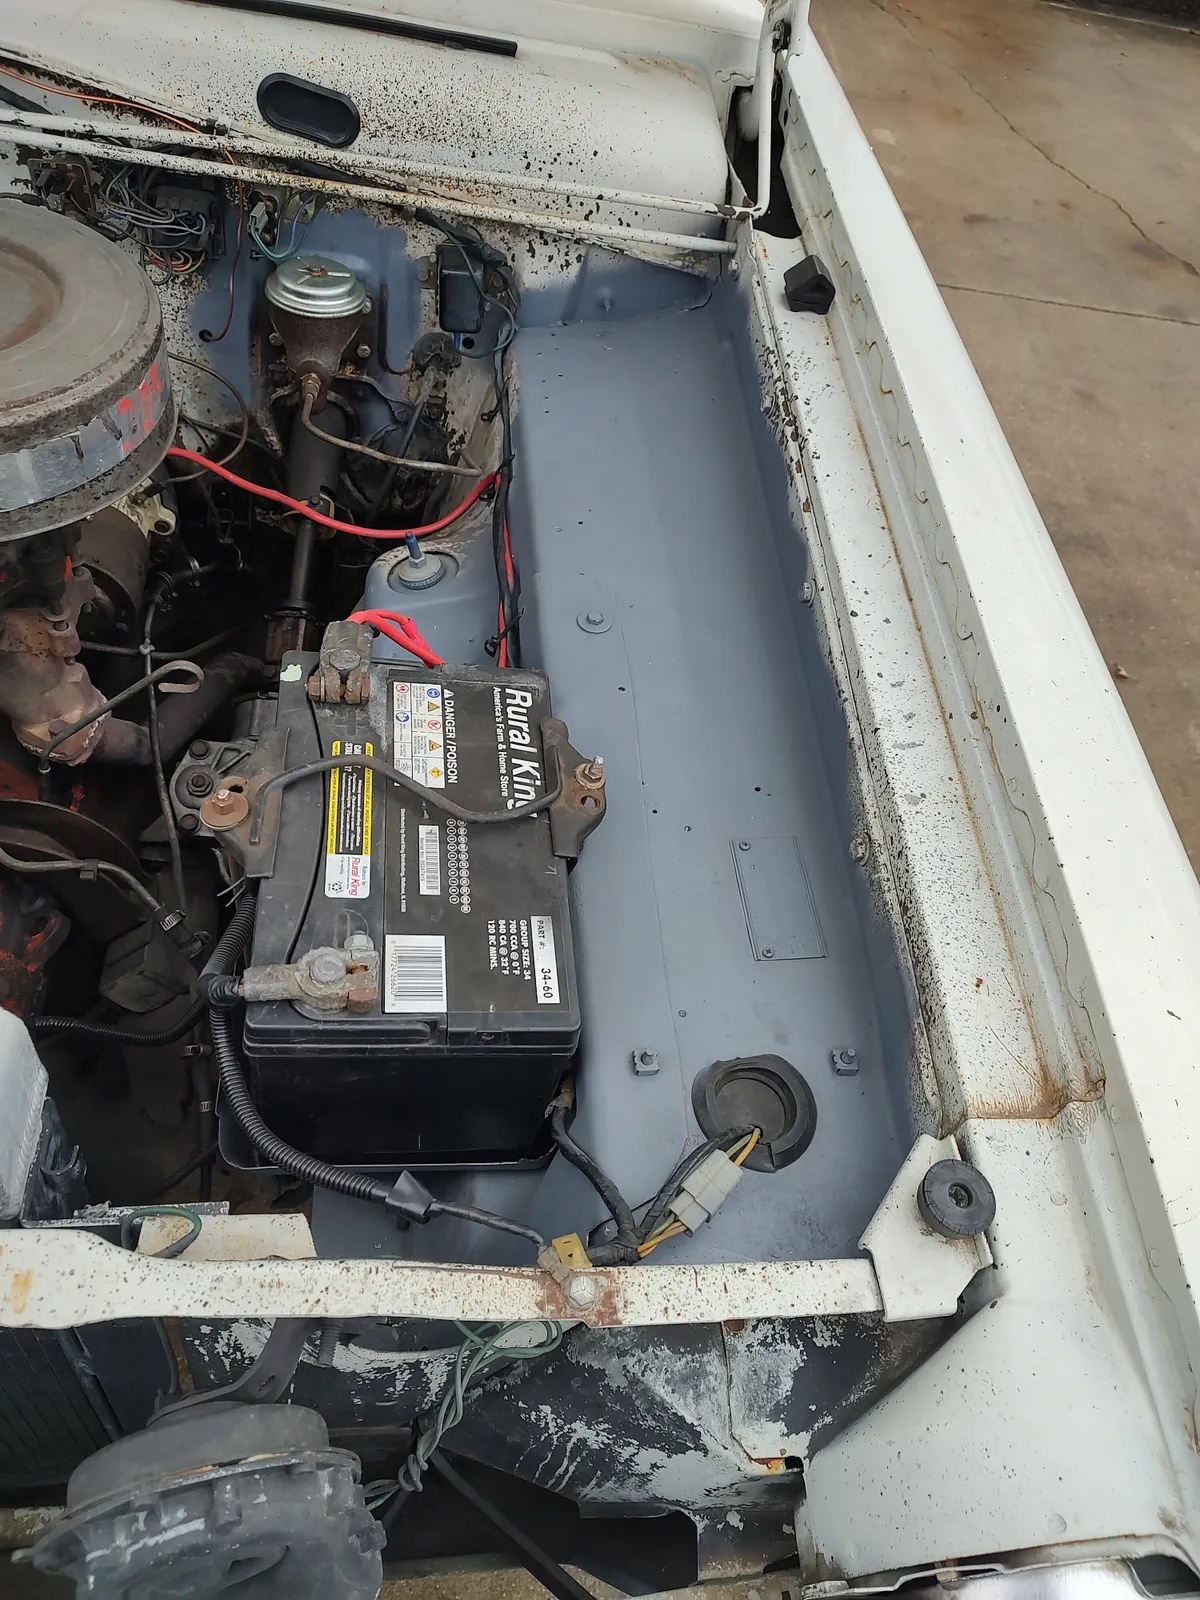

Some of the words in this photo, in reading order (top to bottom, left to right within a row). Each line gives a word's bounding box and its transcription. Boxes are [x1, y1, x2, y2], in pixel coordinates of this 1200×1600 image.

[493, 687, 504, 722] America's
[444, 700, 456, 738] DANGER
[505, 688, 538, 753] Rural
[496, 724, 505, 742] Farm
[498, 752, 508, 773] Home
[500, 776, 509, 796] Store
[352, 857, 360, 877] Rural
[349, 878, 360, 896] King
[487, 920, 495, 934] 120
[498, 919, 506, 933] 840
[509, 920, 517, 933] 700
[519, 920, 528, 947] GROUP
[537, 920, 545, 938] PART
[488, 935, 496, 945] RC
[499, 935, 507, 946] CA
[510, 935, 518, 950] CCA
[539, 941, 546, 950] #:
[489, 946, 497, 970] MINS.
[499, 947, 508, 955] @
[510, 951, 519, 960] @
[522, 949, 530, 968] SIZE:
[523, 969, 531, 980] 34
[541, 968, 554, 998] 34-60
